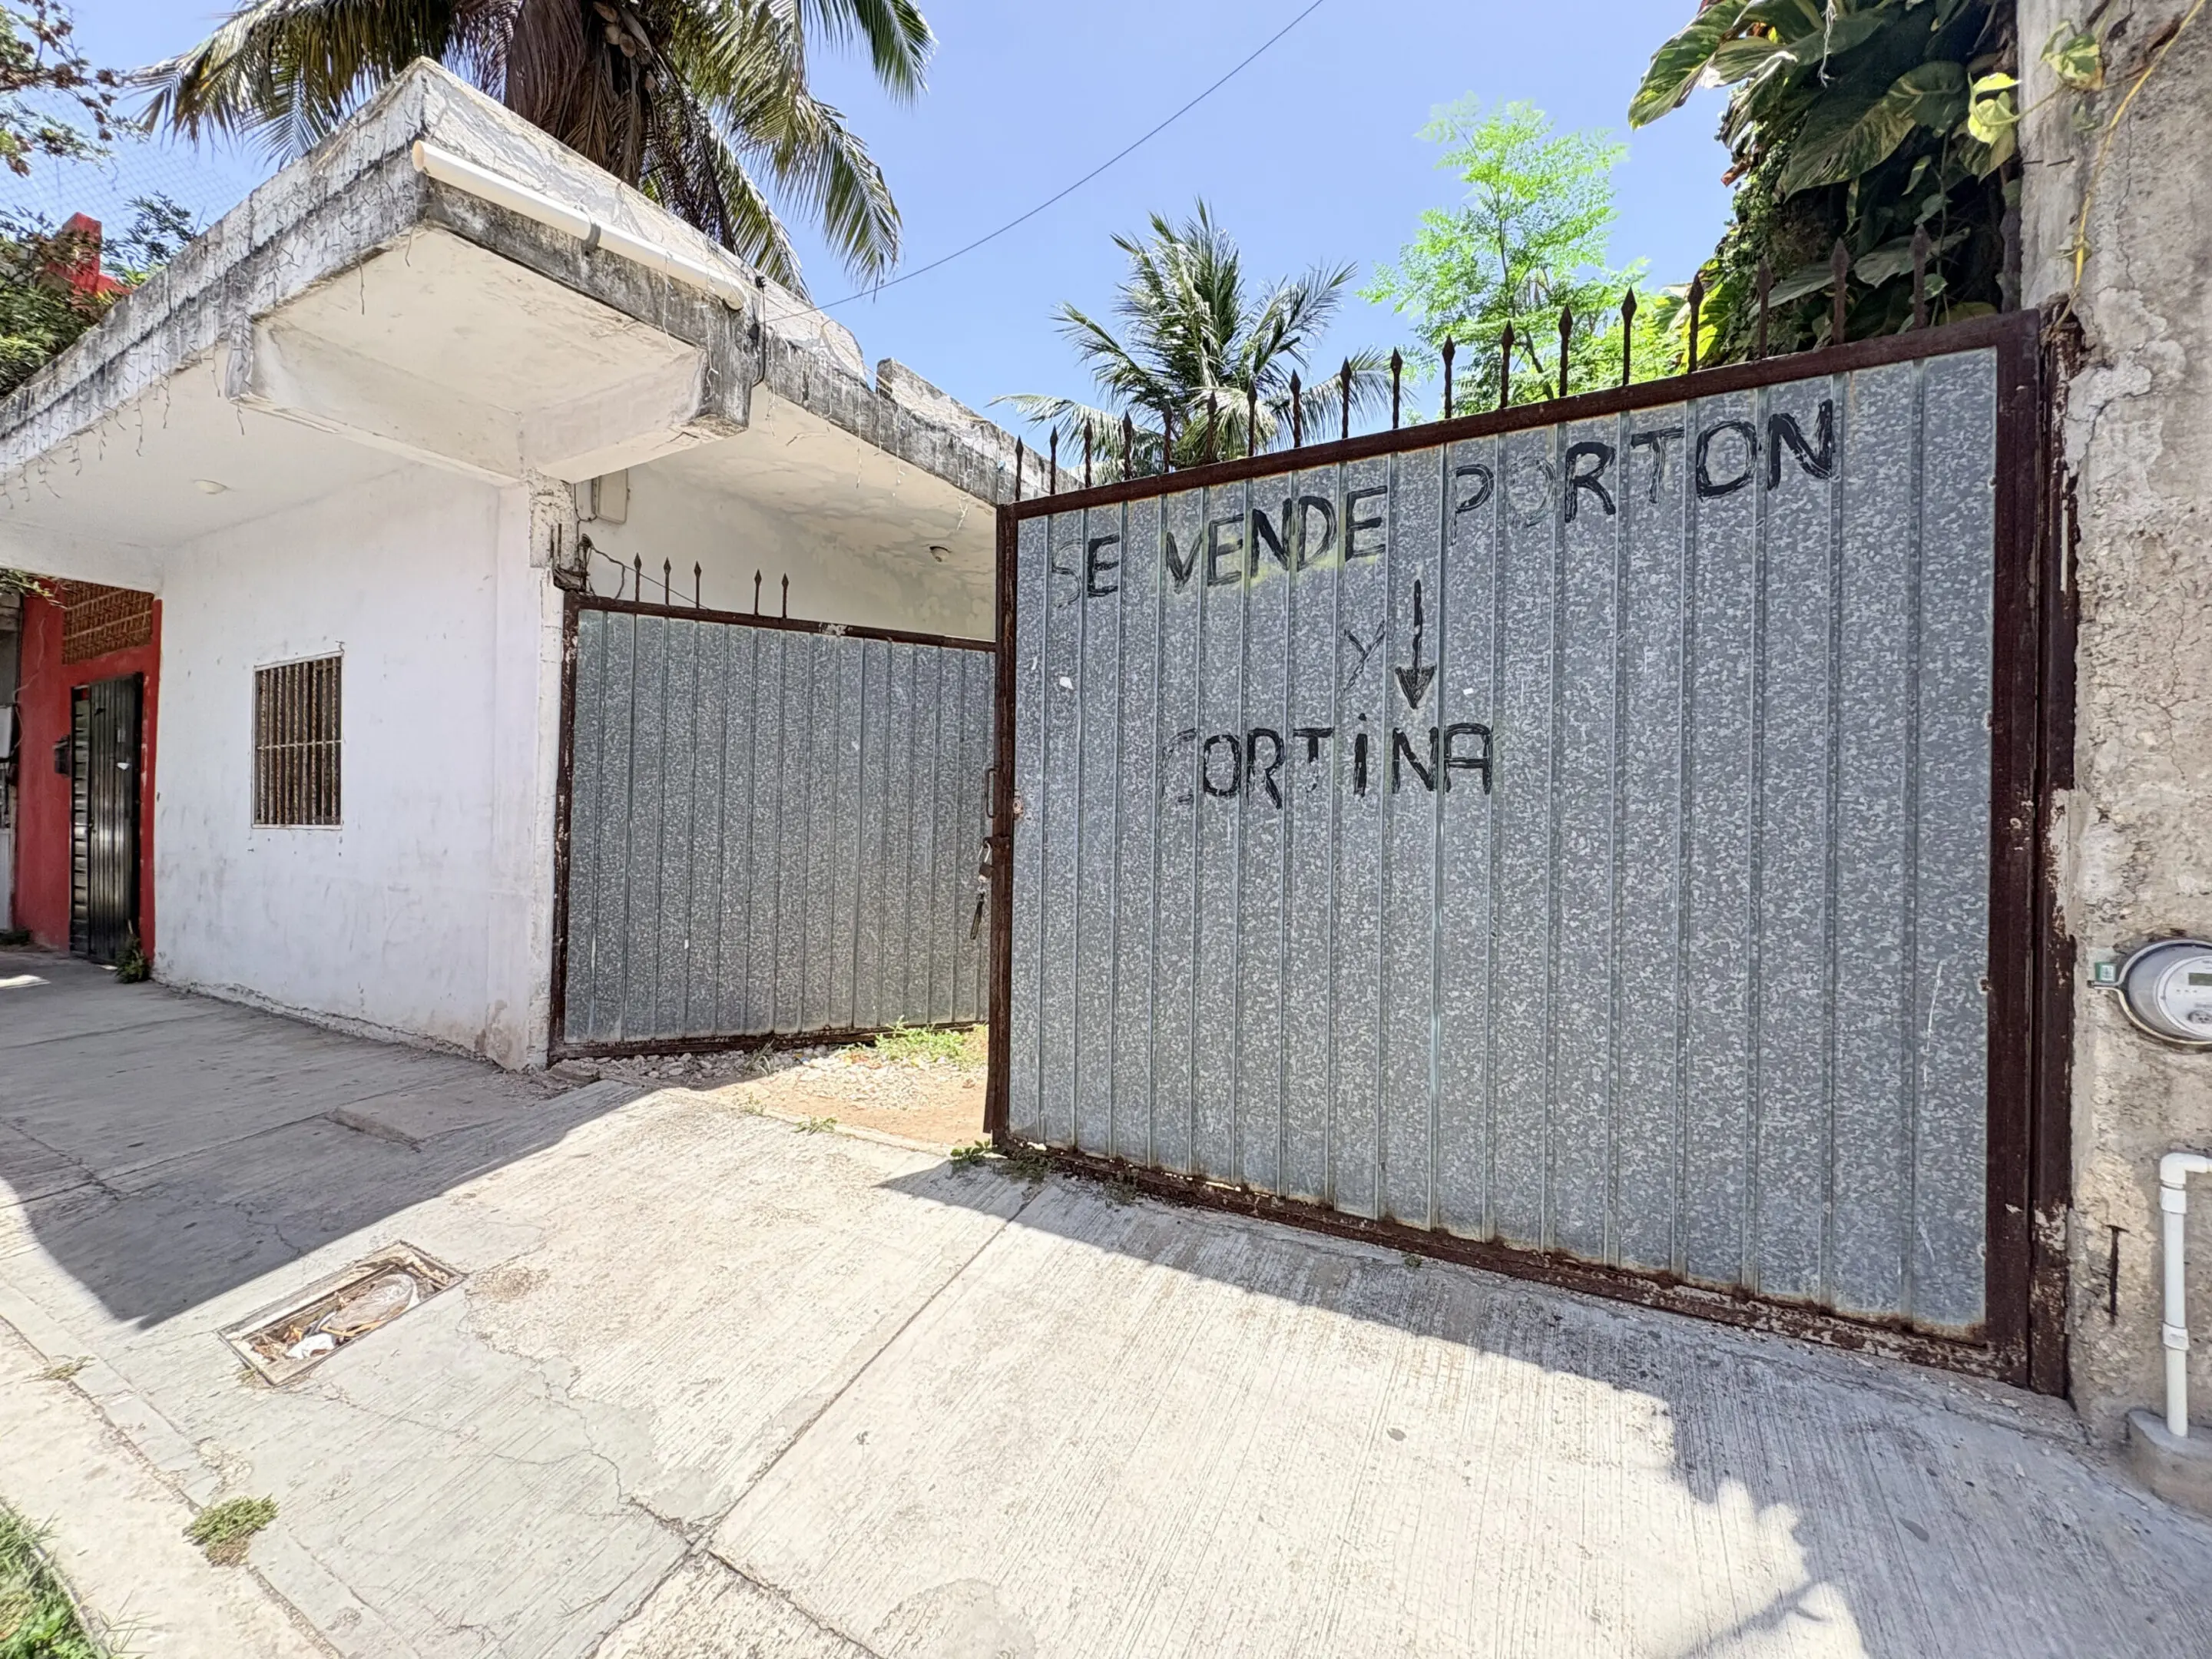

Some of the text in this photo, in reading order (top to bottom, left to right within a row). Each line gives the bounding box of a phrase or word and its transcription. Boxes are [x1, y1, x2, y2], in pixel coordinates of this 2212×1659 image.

[1051, 398, 1836, 610] SE VENDE PORTON
[1343, 619, 1386, 691] Y
